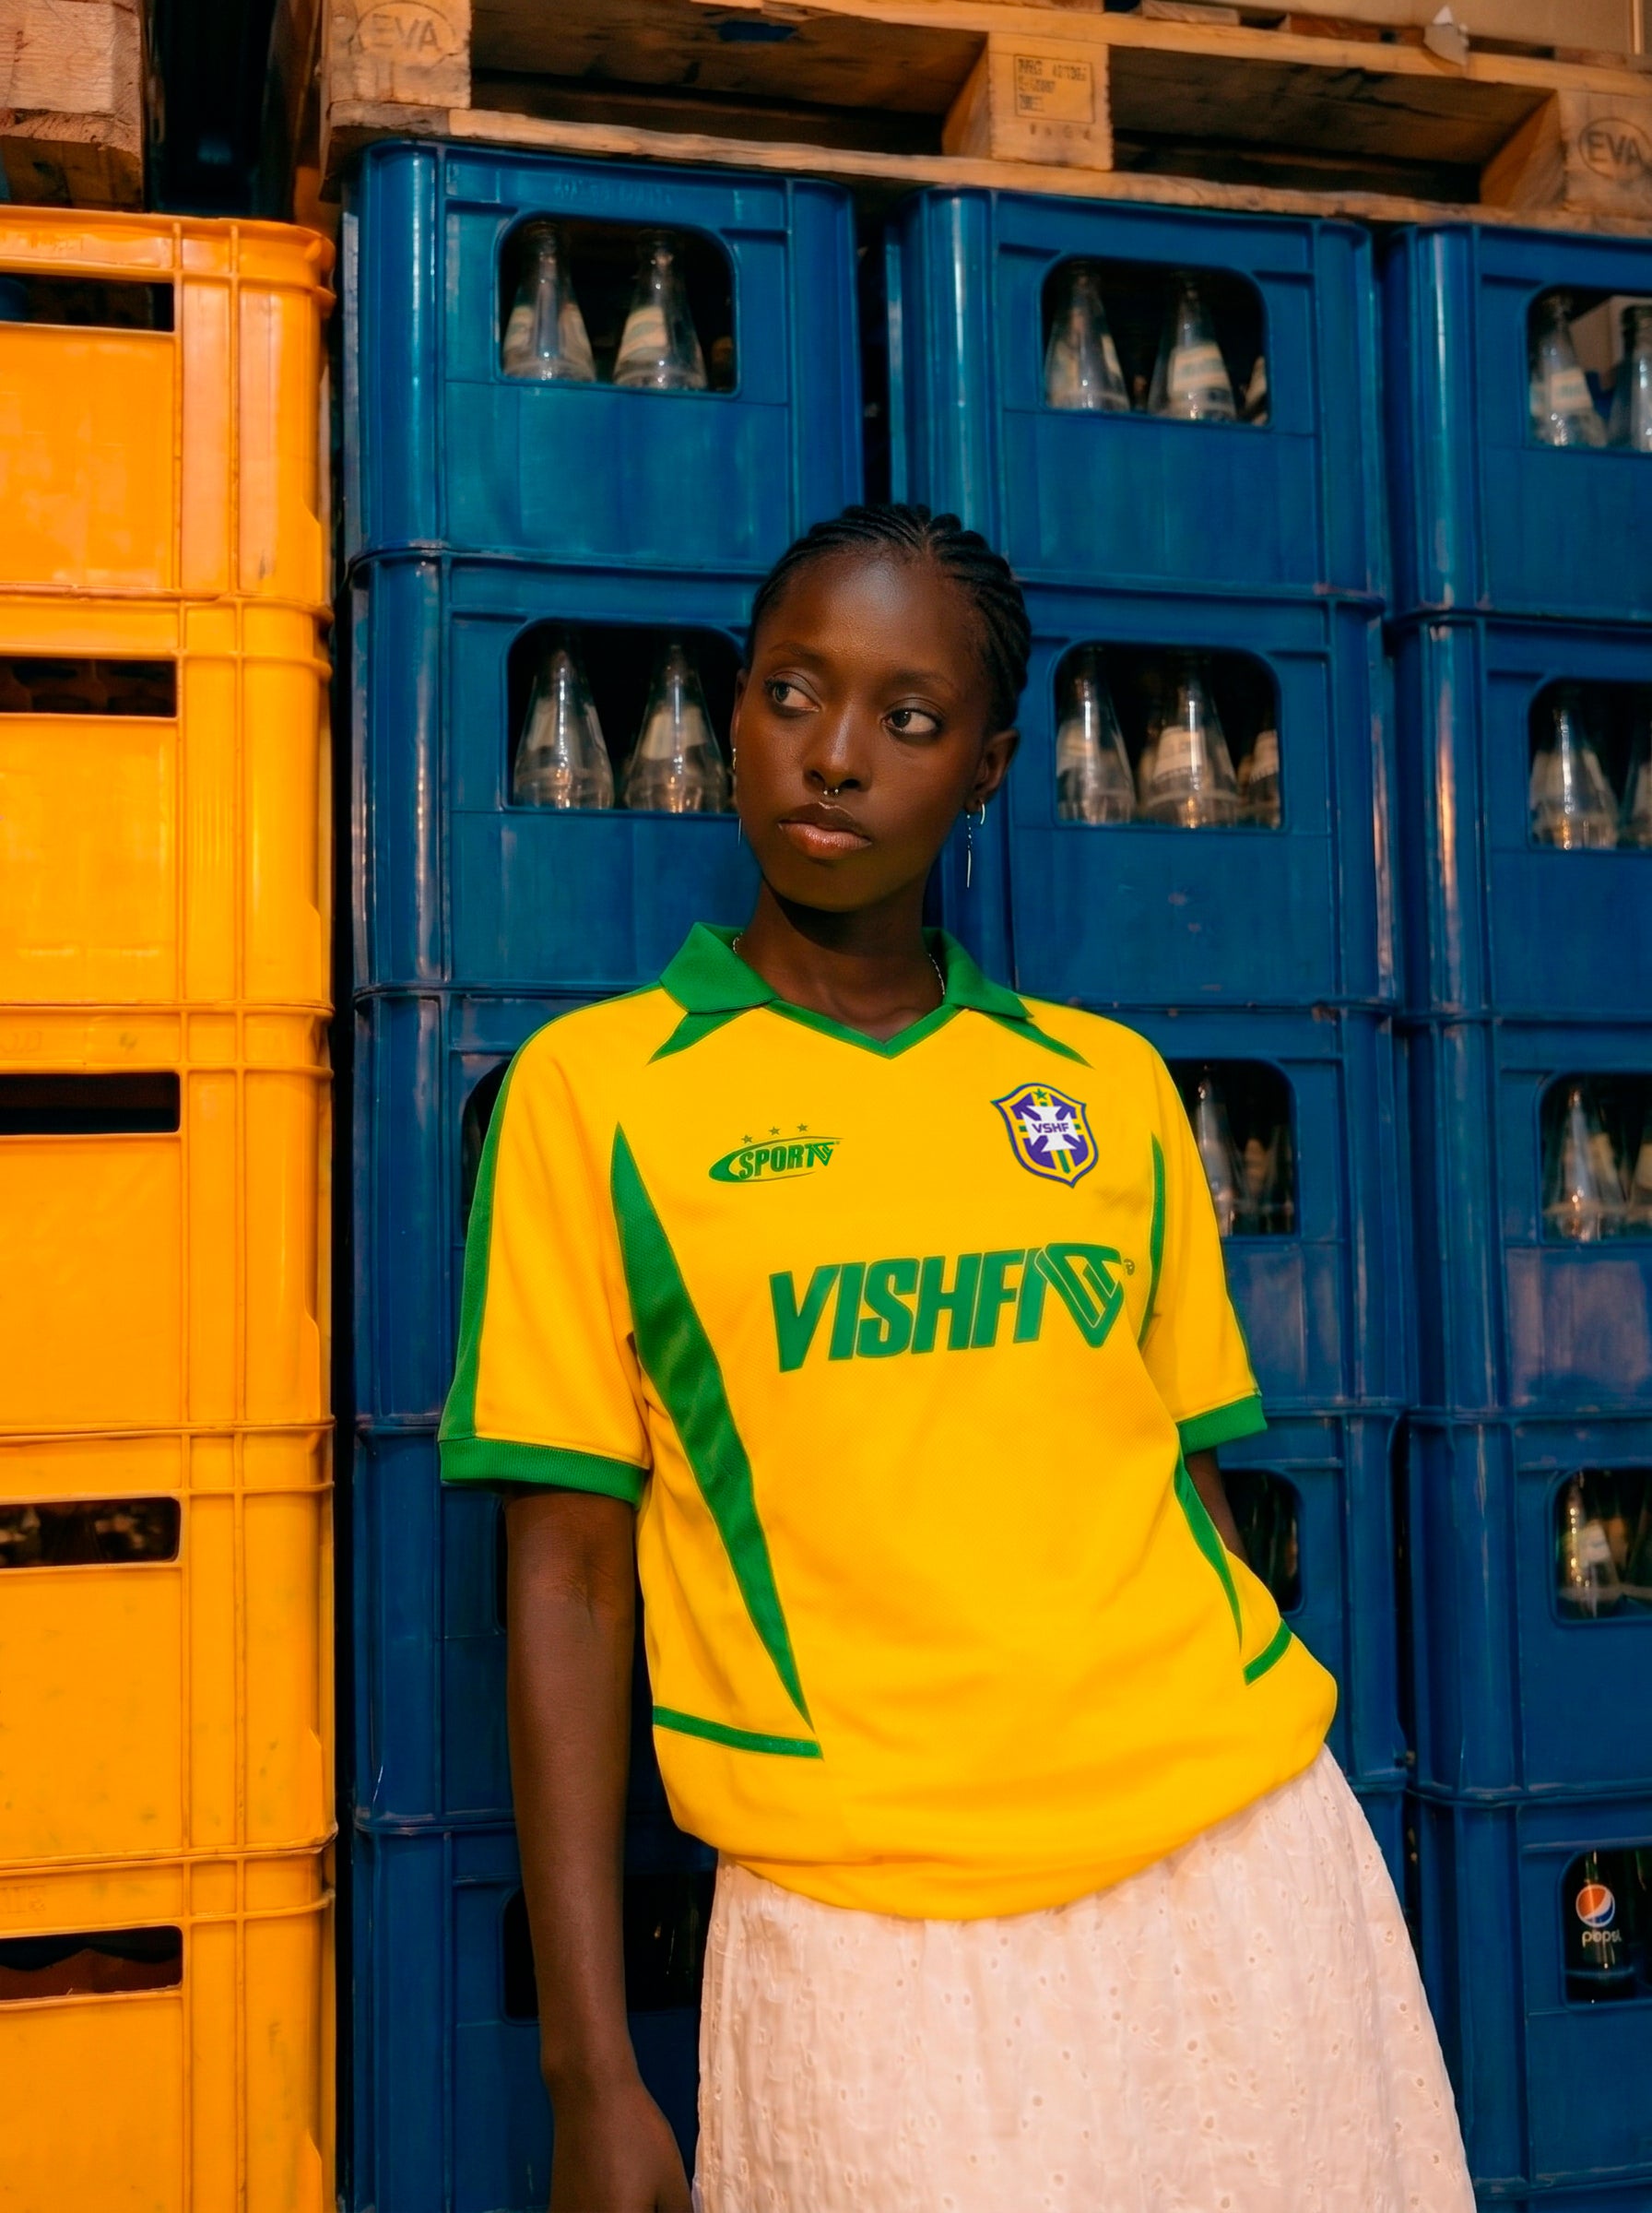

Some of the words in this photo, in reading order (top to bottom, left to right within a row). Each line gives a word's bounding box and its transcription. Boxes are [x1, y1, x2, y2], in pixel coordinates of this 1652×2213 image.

[1587, 131, 1644, 166] EVA
[1031, 1121, 1070, 1134] VSHF
[1581, 1929, 1622, 1947] pepsi
